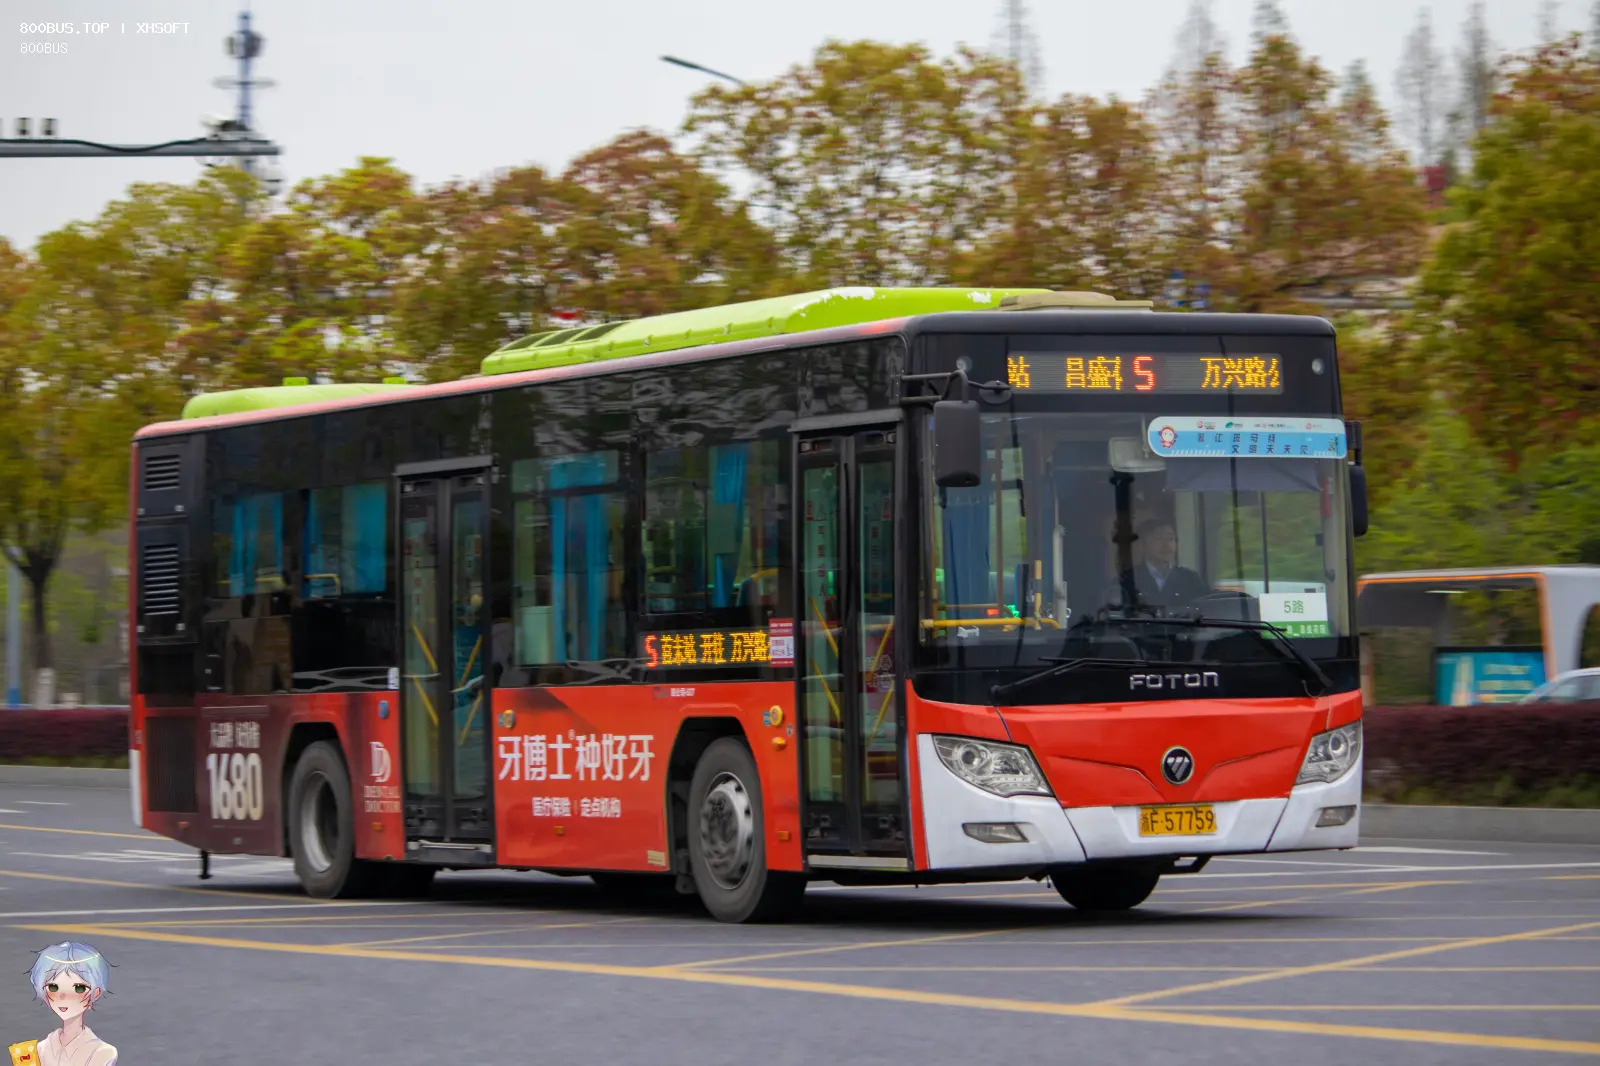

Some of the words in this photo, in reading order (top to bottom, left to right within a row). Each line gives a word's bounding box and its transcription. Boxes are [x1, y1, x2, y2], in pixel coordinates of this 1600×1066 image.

[1132, 355, 1155, 391] 5
[1283, 599, 1305, 614] 5路
[644, 634, 659, 668] 5
[730, 630, 772, 663] 万兴路
[1129, 671, 1220, 690] FOTON
[205, 752, 264, 821] 1680
